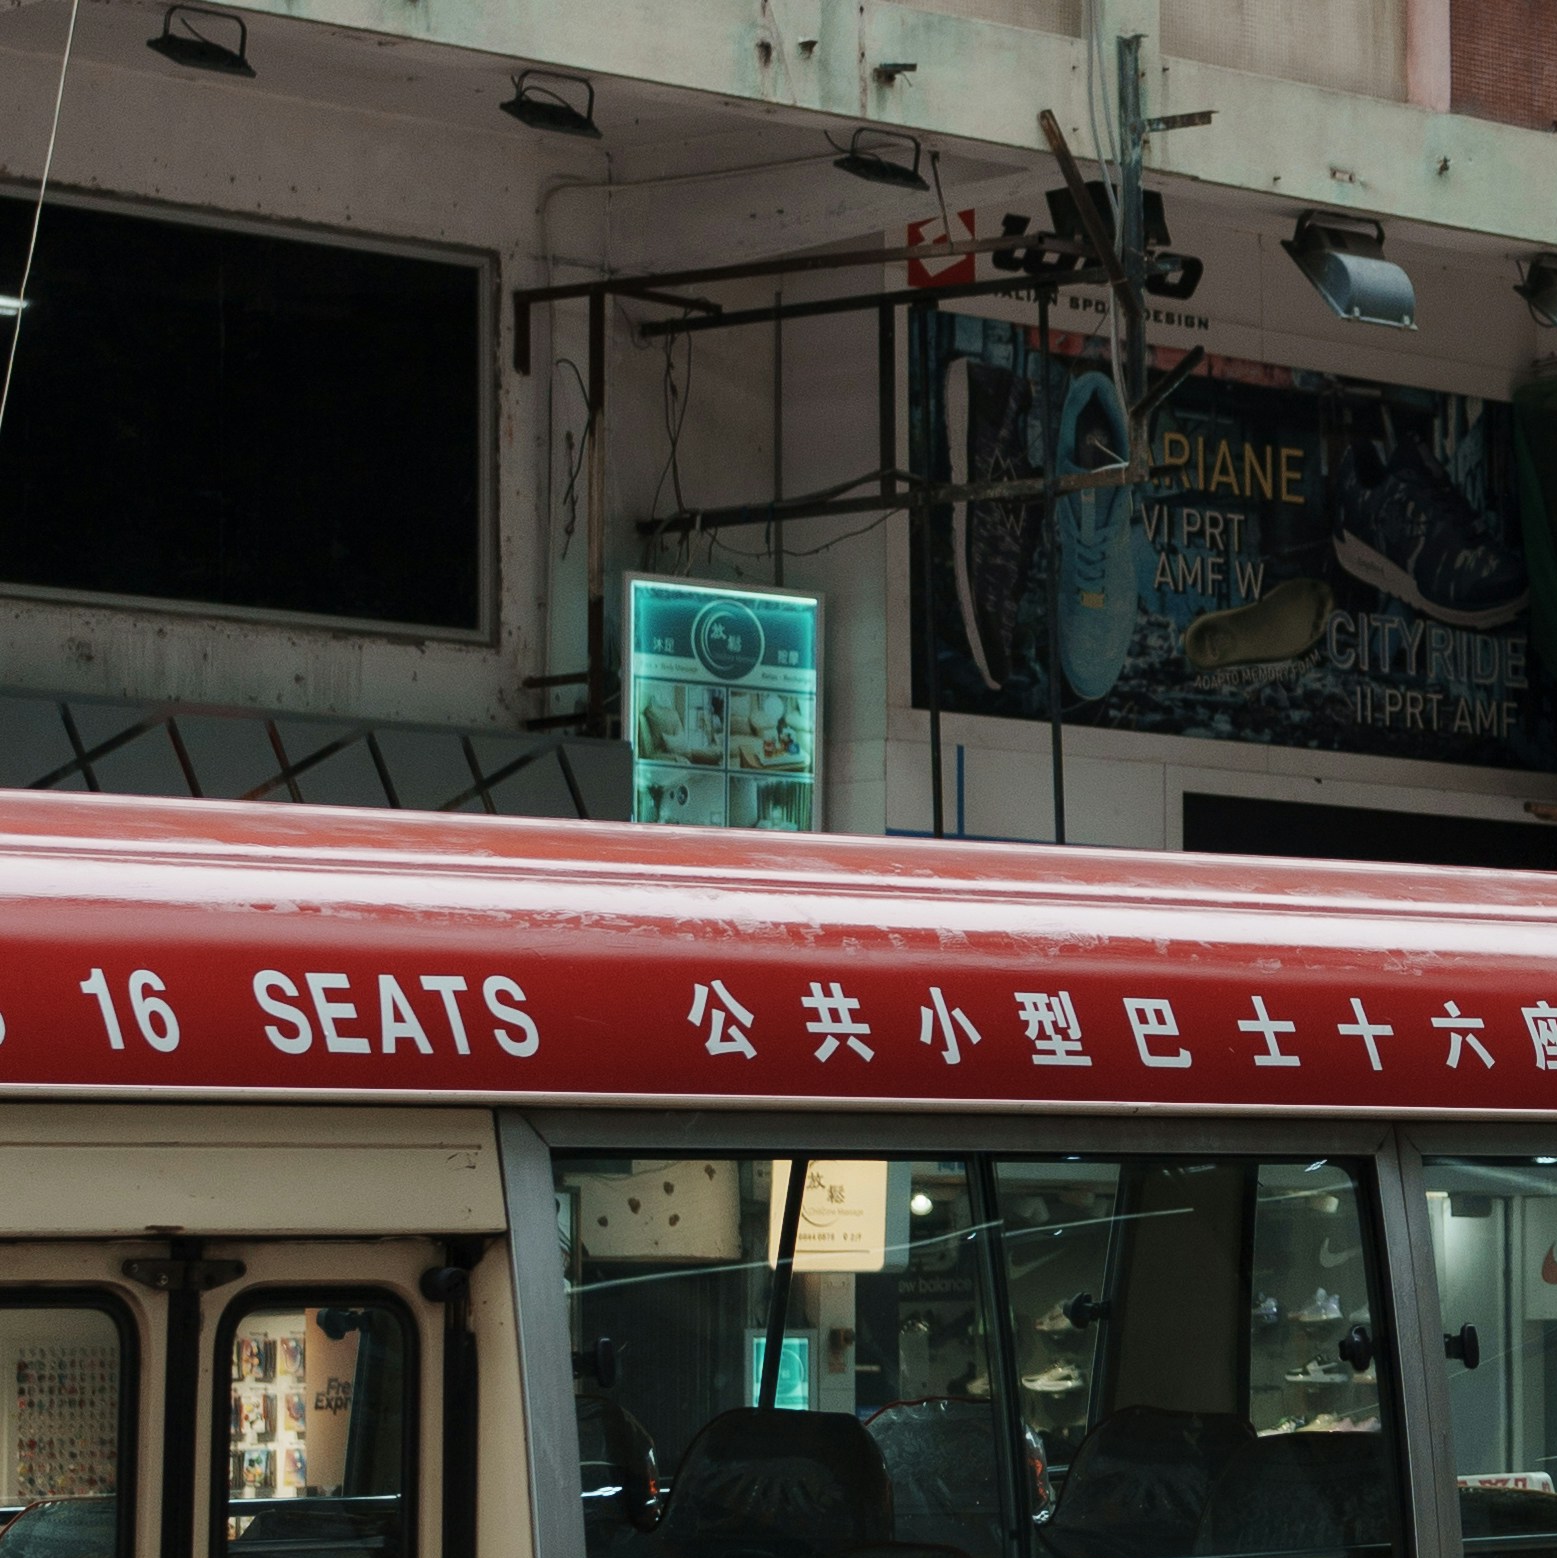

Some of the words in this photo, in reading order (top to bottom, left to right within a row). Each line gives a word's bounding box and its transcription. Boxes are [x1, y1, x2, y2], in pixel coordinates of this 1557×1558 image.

[1141, 502, 1170, 545] VI
[1182, 506, 1245, 553] PRT
[1153, 551, 1225, 596] AMF
[1234, 558, 1265, 601] W
[1326, 609, 1530, 690] CITYRIDE
[1384, 686, 1444, 733] PRT
[1453, 697, 1520, 739] AMF
[79, 967, 182, 1054] 16
[251, 968, 541, 1059] SEATS
